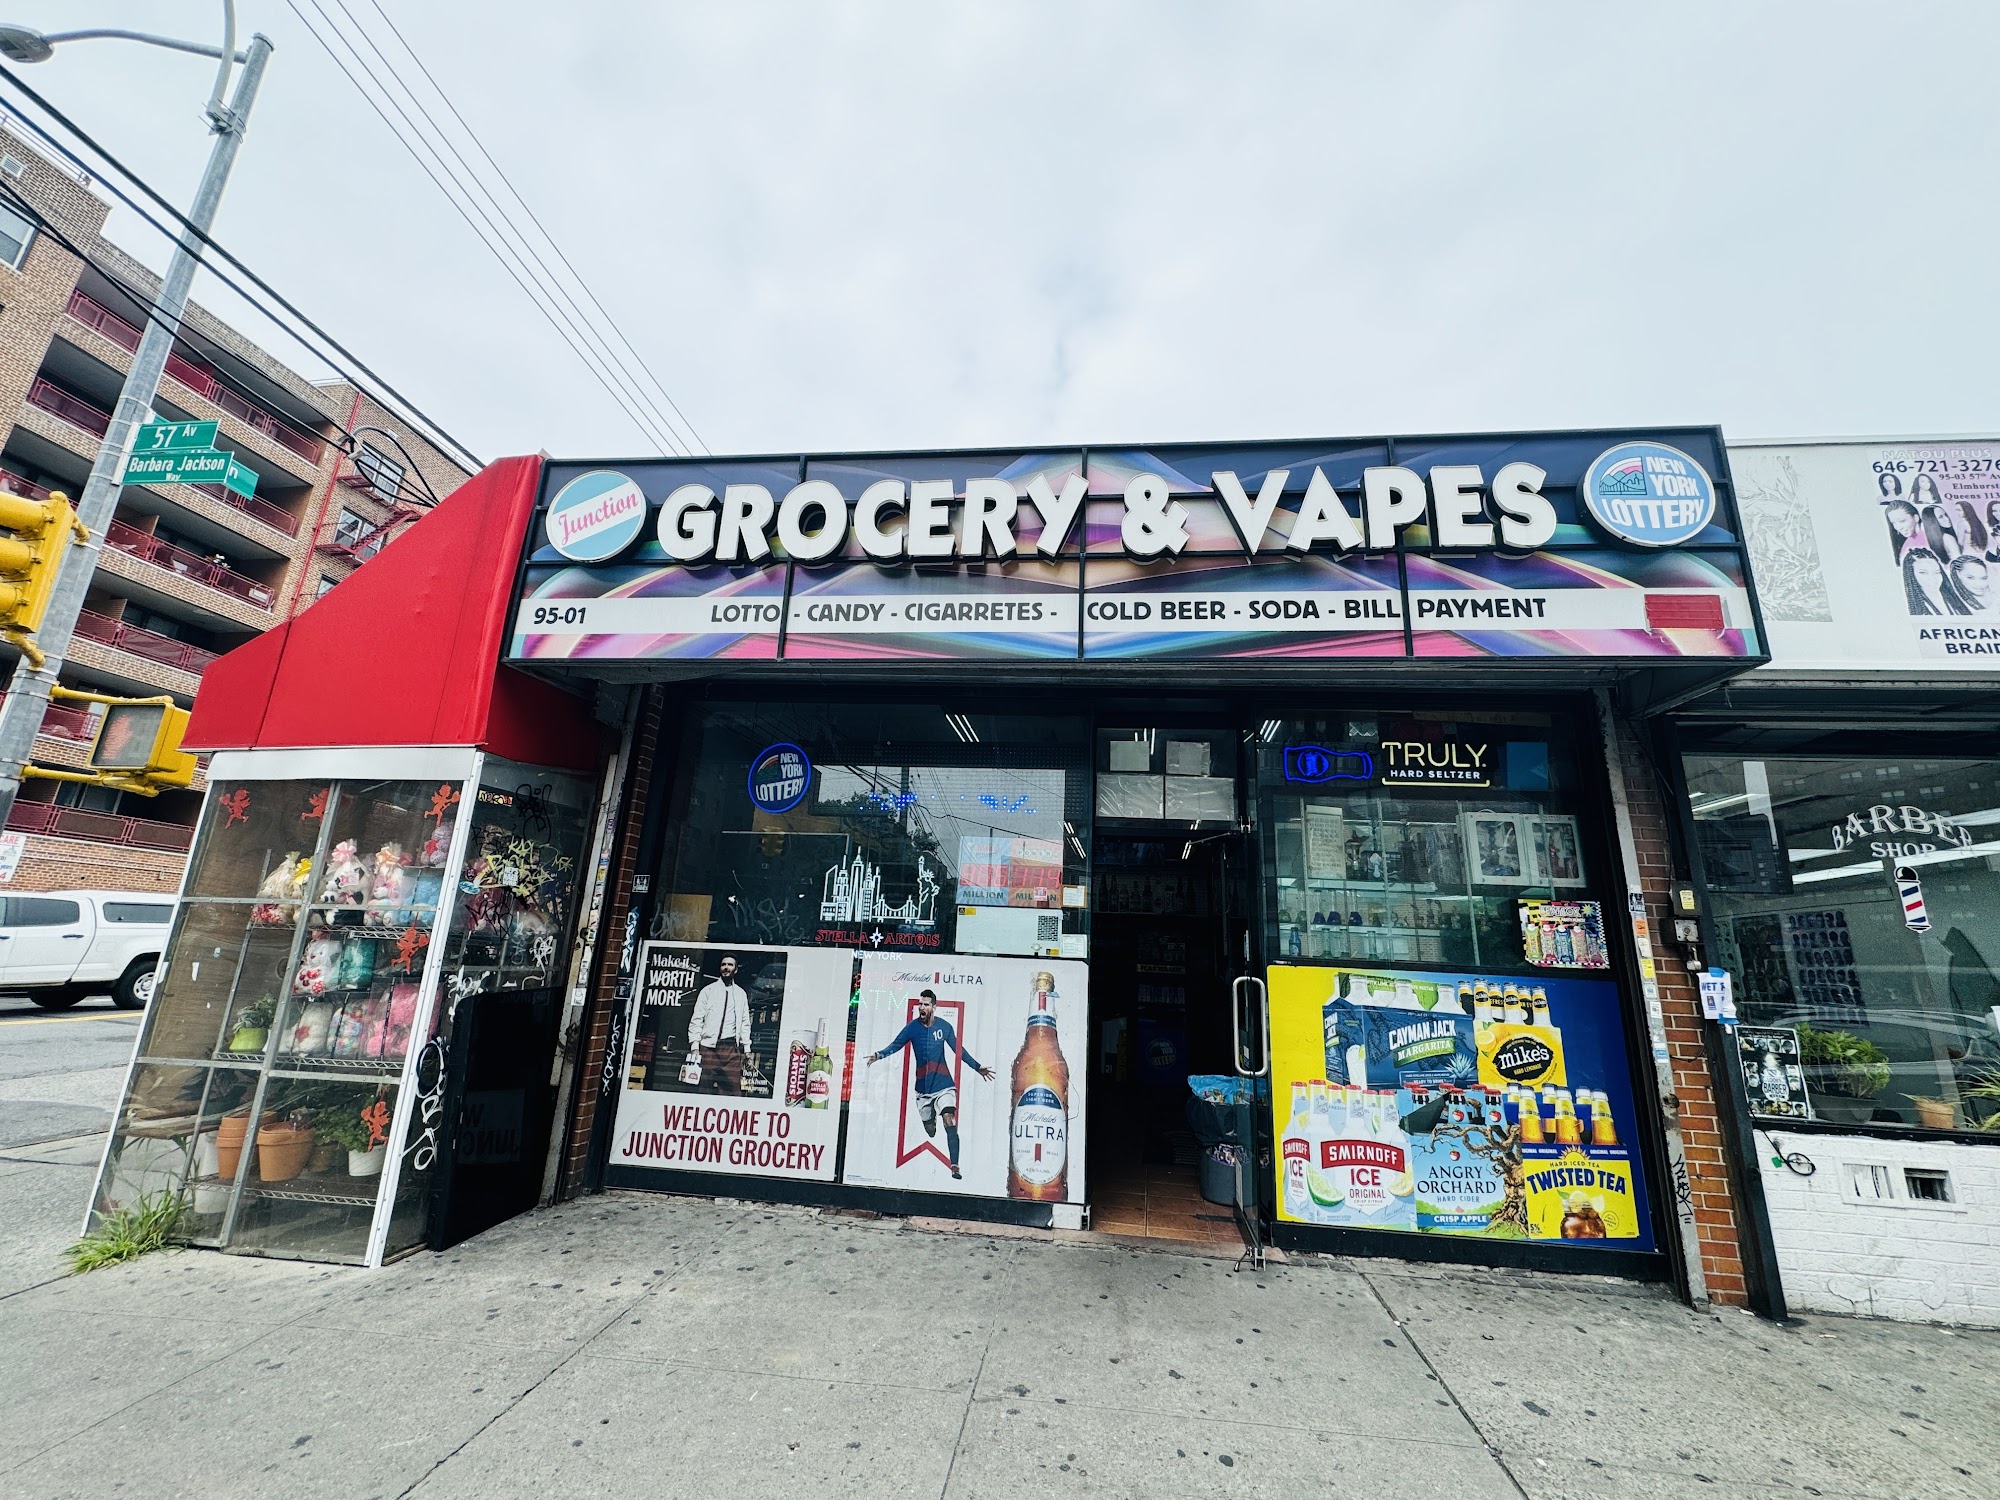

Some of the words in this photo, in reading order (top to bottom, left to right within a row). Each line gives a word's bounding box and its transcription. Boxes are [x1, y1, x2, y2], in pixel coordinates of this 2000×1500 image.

[152, 426, 177, 448] 57
[182, 424, 197, 437] Av
[1882, 449, 1945, 460] NATOU
[1950, 448, 1992, 459] PLUS
[129, 457, 174, 473] Barbara
[177, 455, 225, 471] Jackson
[1646, 456, 1687, 476] NEW
[165, 472, 181, 482] Way
[1649, 474, 1700, 497] YORK
[557, 489, 640, 546] Junction
[657, 472, 1090, 562] GROCERY
[1121, 473, 1189, 556] &
[1211, 461, 1558, 556] VAPES
[1602, 498, 1705, 529] LOTTERY
[534, 606, 587, 625] 95-01
[711, 603, 780, 623] LOTTO
[808, 602, 885, 623] CANDY
[904, 602, 1043, 622] CIGARRETES
[1087, 601, 1152, 621] COLD
[1161, 600, 1226, 620] BEER
[1249, 600, 1320, 620] SODA
[1344, 599, 1402, 619] BILL
[1418, 598, 1546, 618] PAYMENT
[1920, 628, 2000, 640] AFRICAN
[780, 753, 798, 764] NEW
[780, 764, 803, 779] YORK
[1390, 769, 1424, 779] HARD
[1427, 770, 1481, 780] SELTZER
[755, 777, 804, 801] LOTTERY
[1831, 804, 1978, 858] BARBER
[1870, 842, 1938, 859] SHOP
[962, 890, 1004, 899] MILLION
[815, 930, 869, 944] STELLA
[884, 932, 940, 946] ARTOIS
[651, 953, 680, 967] Make
[682, 954, 691, 969] it
[851, 950, 873, 960] NEW
[876, 951, 902, 961] YORK
[648, 969, 695, 988] WORTH
[892, 971, 932, 983] Michelob
[943, 974, 984, 985] ULTRA
[1701, 982, 1717, 991] WET
[645, 988, 683, 1007] MORE
[848, 988, 909, 1011] ATM
[932, 1029, 943, 1041] 10
[1389, 1021, 1431, 1050] CAYMAN
[1431, 1019, 1456, 1038] JACK
[1398, 1040, 1451, 1061] MARGARITA
[1498, 1045, 1550, 1070] mike's
[788, 1054, 799, 1096] ARTOIS
[798, 1054, 807, 1095] STELLA
[663, 1104, 760, 1138] WELCOME
[766, 1113, 791, 1138] TO
[1021, 1112, 1057, 1123] Michelob
[1014, 1125, 1064, 1142] ULTRA
[622, 1131, 725, 1162] JUNCTION
[729, 1137, 825, 1171] GROCERY
[1284, 1142, 1308, 1156] SMIRNOFF
[1329, 1145, 1398, 1165] SMIRNOFF
[1289, 1159, 1303, 1177] ICE
[1350, 1168, 1382, 1186] ICE
[1428, 1166, 1482, 1179] ANGRY
[1417, 1180, 1496, 1194] ORCHARD
[1526, 1167, 1595, 1195] TWISTED
[1597, 1170, 1626, 1195] TEA
[1349, 1188, 1387, 1199] ORIGINAL
[1434, 1215, 1460, 1223] CRISP
[1460, 1215, 1487, 1223] APPLE
[1529, 1223, 1541, 1231] 5%
